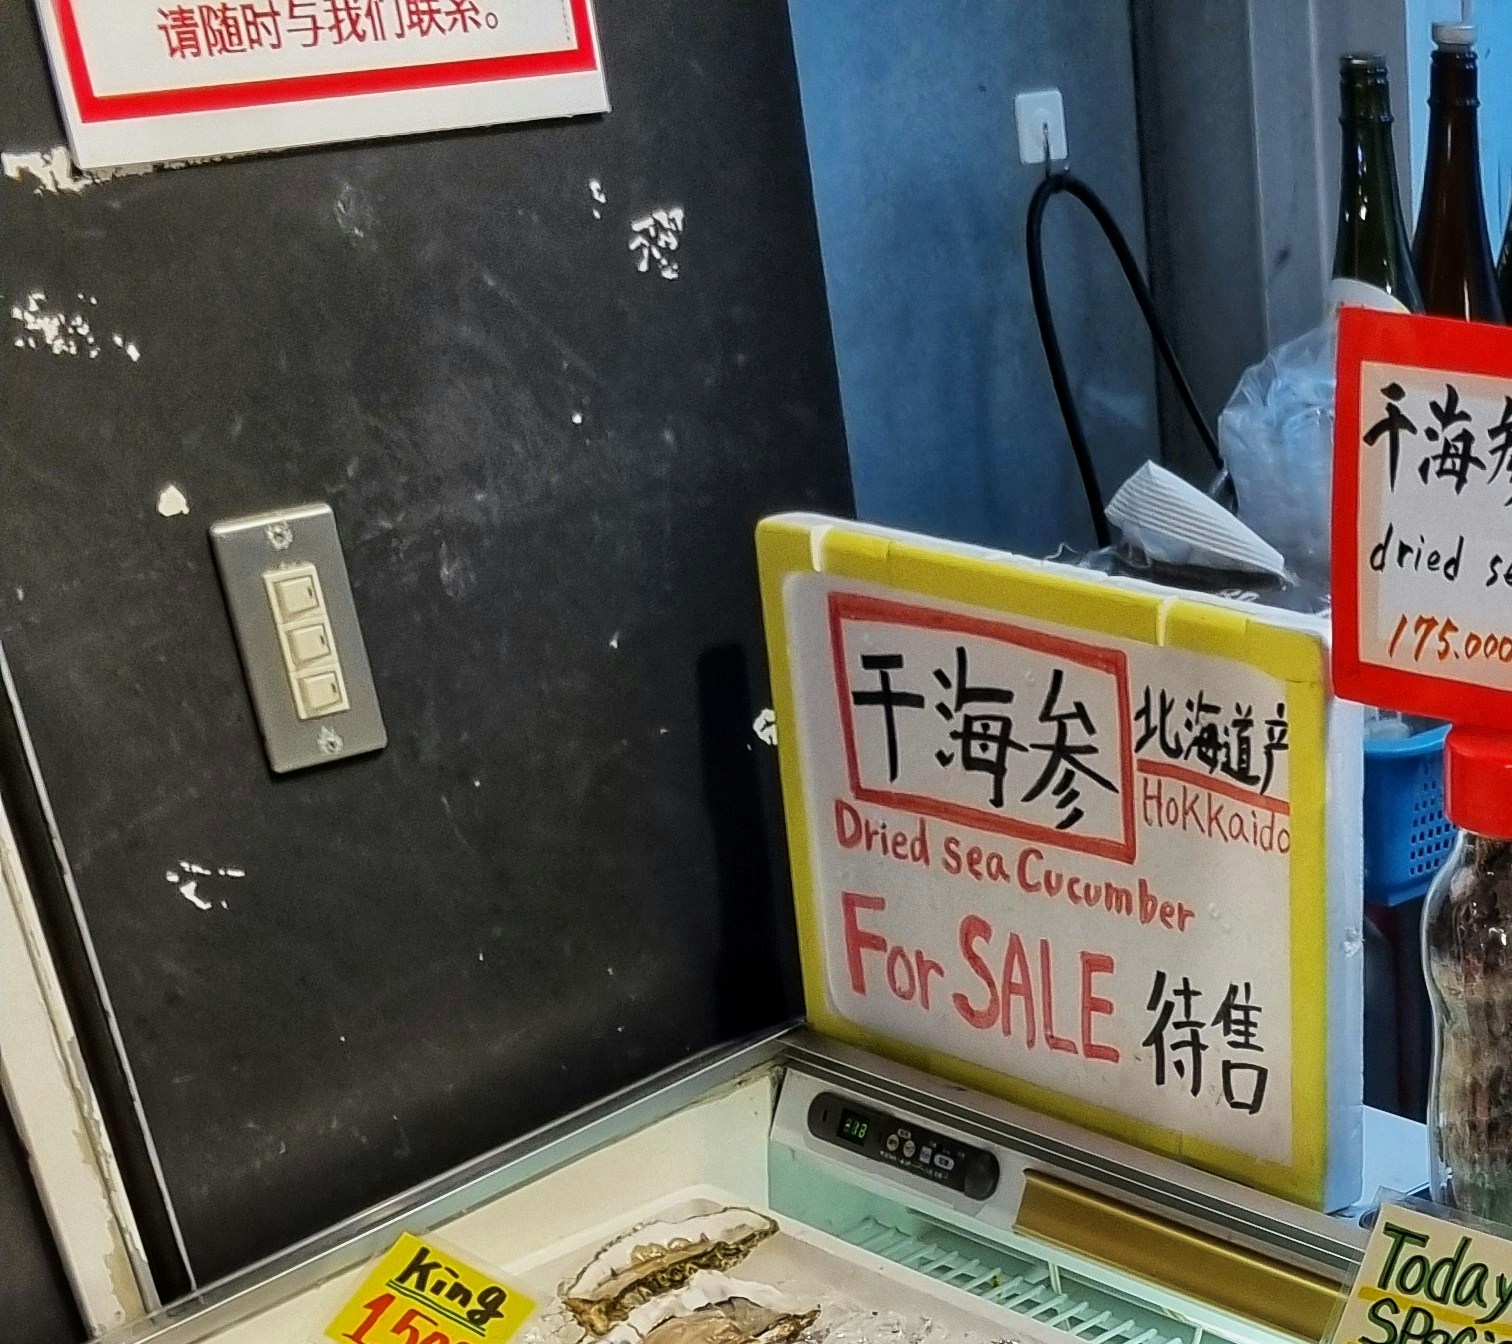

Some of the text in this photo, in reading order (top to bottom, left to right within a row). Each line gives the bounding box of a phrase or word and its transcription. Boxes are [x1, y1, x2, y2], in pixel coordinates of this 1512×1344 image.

[1370, 523, 1464, 588] dried
[852, 645, 1120, 831] 干海参
[1133, 684, 1289, 795] 北海道产
[834, 800, 930, 868] Dried
[1017, 849, 1196, 933] Cucumber
[841, 891, 1120, 1064] For SALE
[1142, 970, 1269, 1115] 待售
[395, 1246, 507, 1327] King
